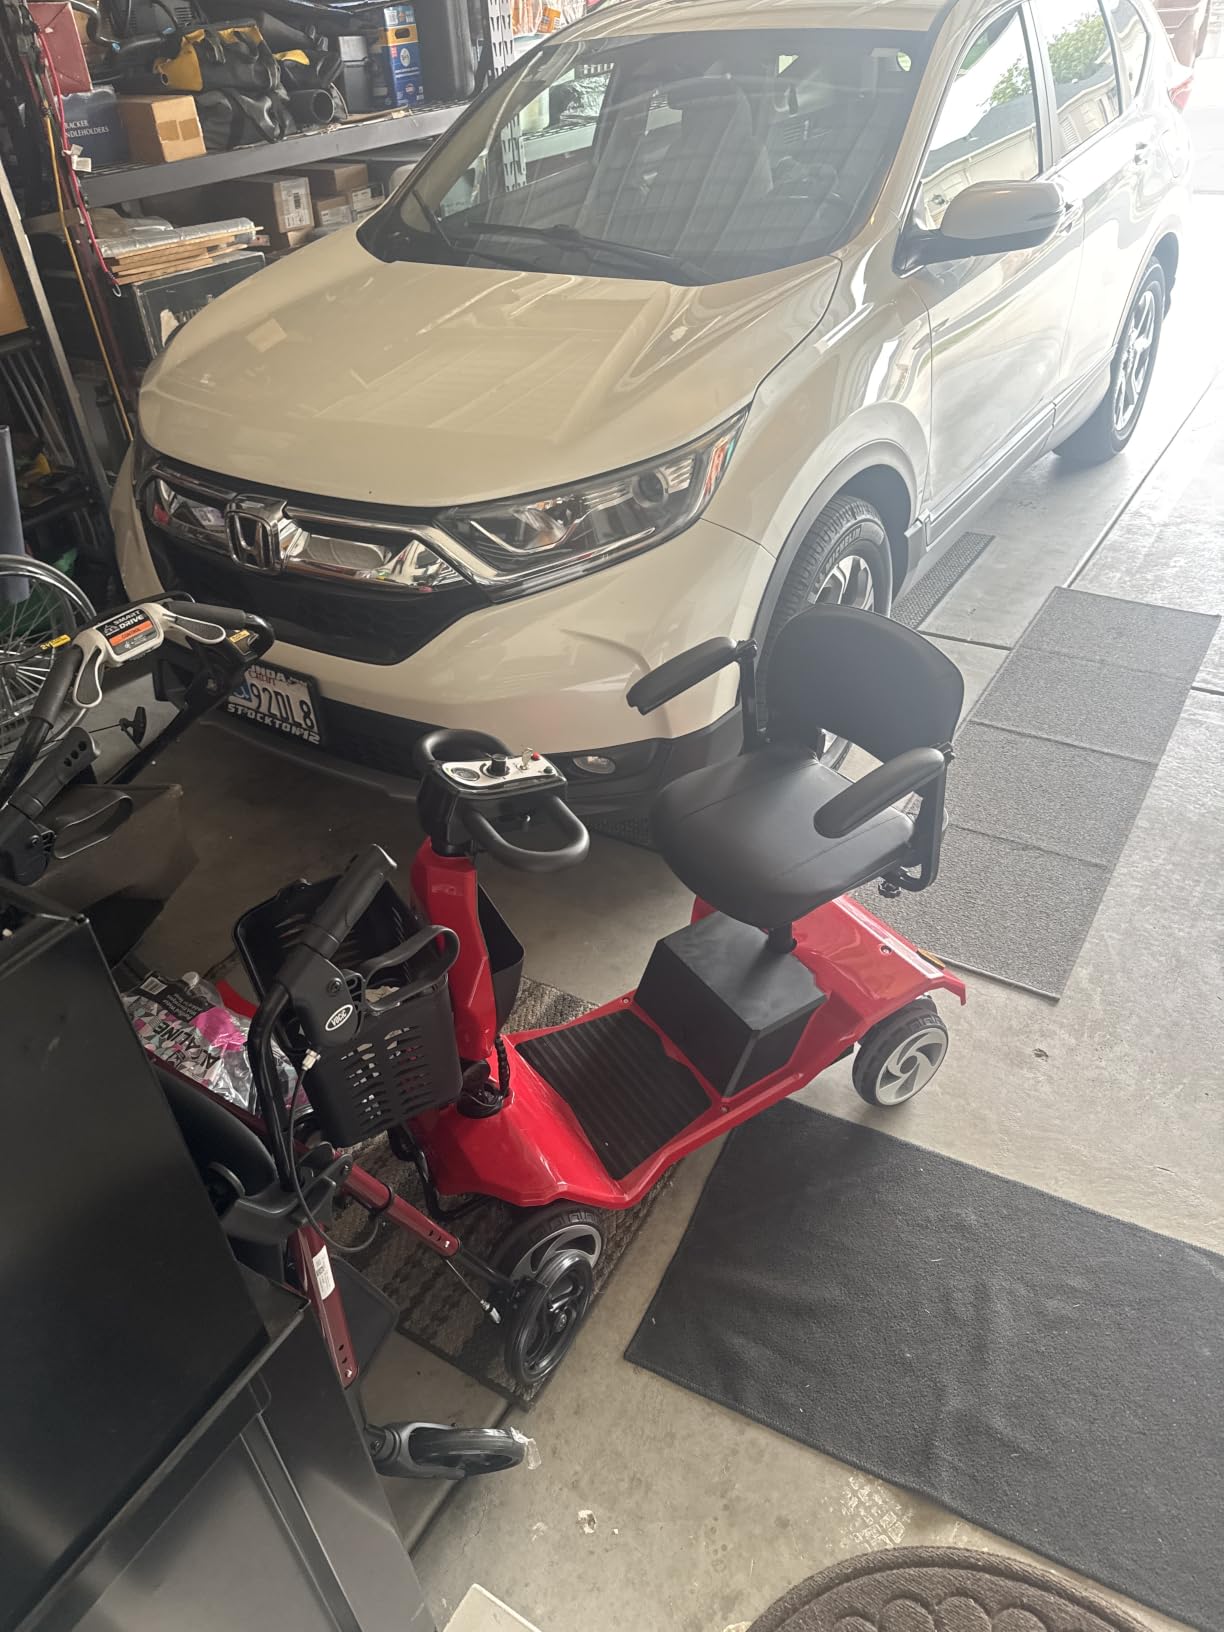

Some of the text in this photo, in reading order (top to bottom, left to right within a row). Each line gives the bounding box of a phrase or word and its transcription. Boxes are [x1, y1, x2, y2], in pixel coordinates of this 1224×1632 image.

[113, 610, 141, 625] SMART
[119, 614, 145, 630] DRIVE
[227, 703, 303, 736] STOCKTON
